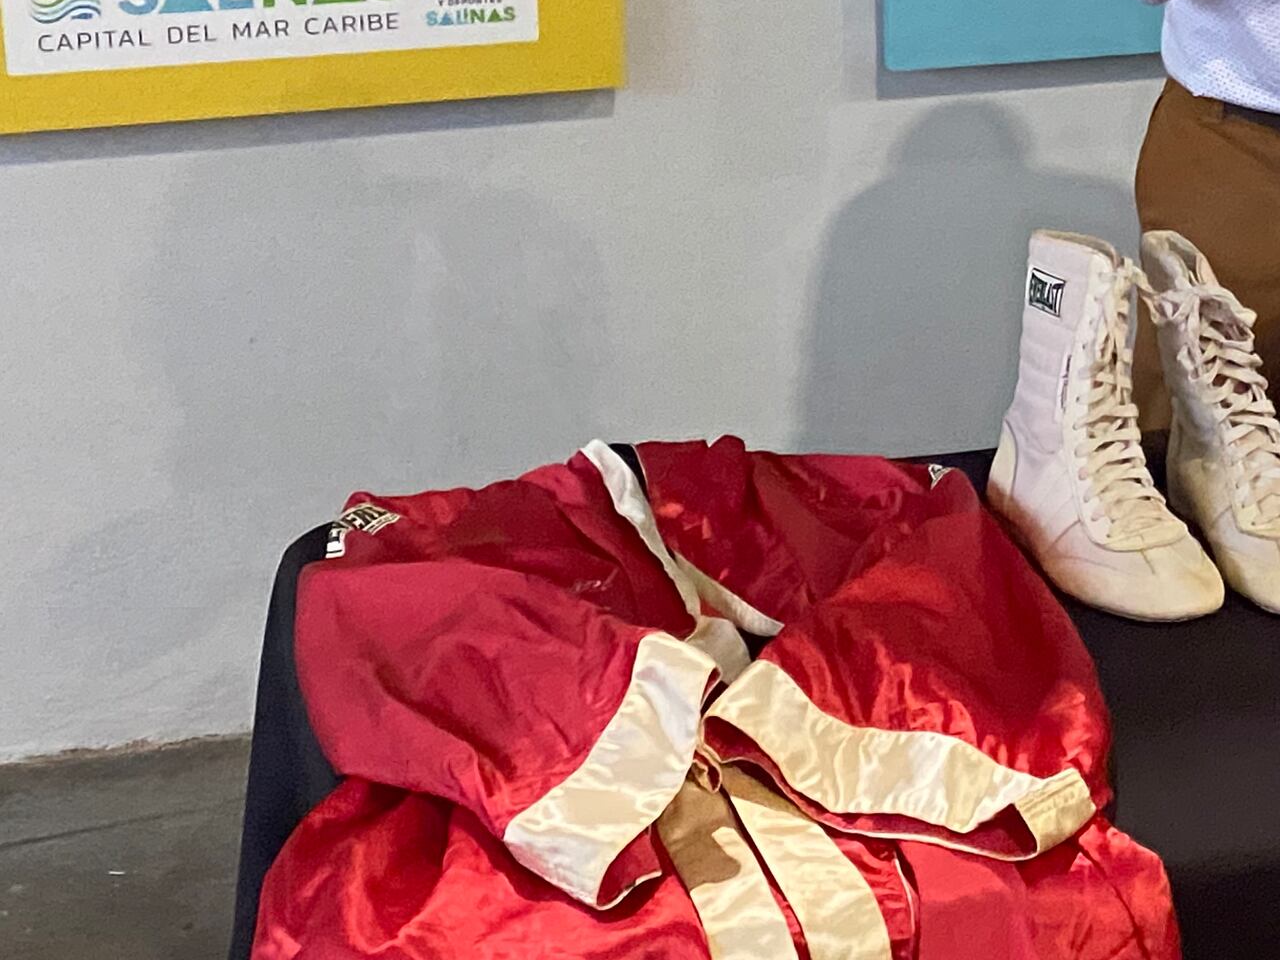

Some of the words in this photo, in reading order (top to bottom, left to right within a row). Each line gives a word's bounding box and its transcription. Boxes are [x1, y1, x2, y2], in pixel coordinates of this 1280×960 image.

[37, 27, 152, 53] CAPITAL
[166, 24, 217, 45] DEL
[231, 18, 290, 38] MAR
[303, 11, 400, 33] CARIBE
